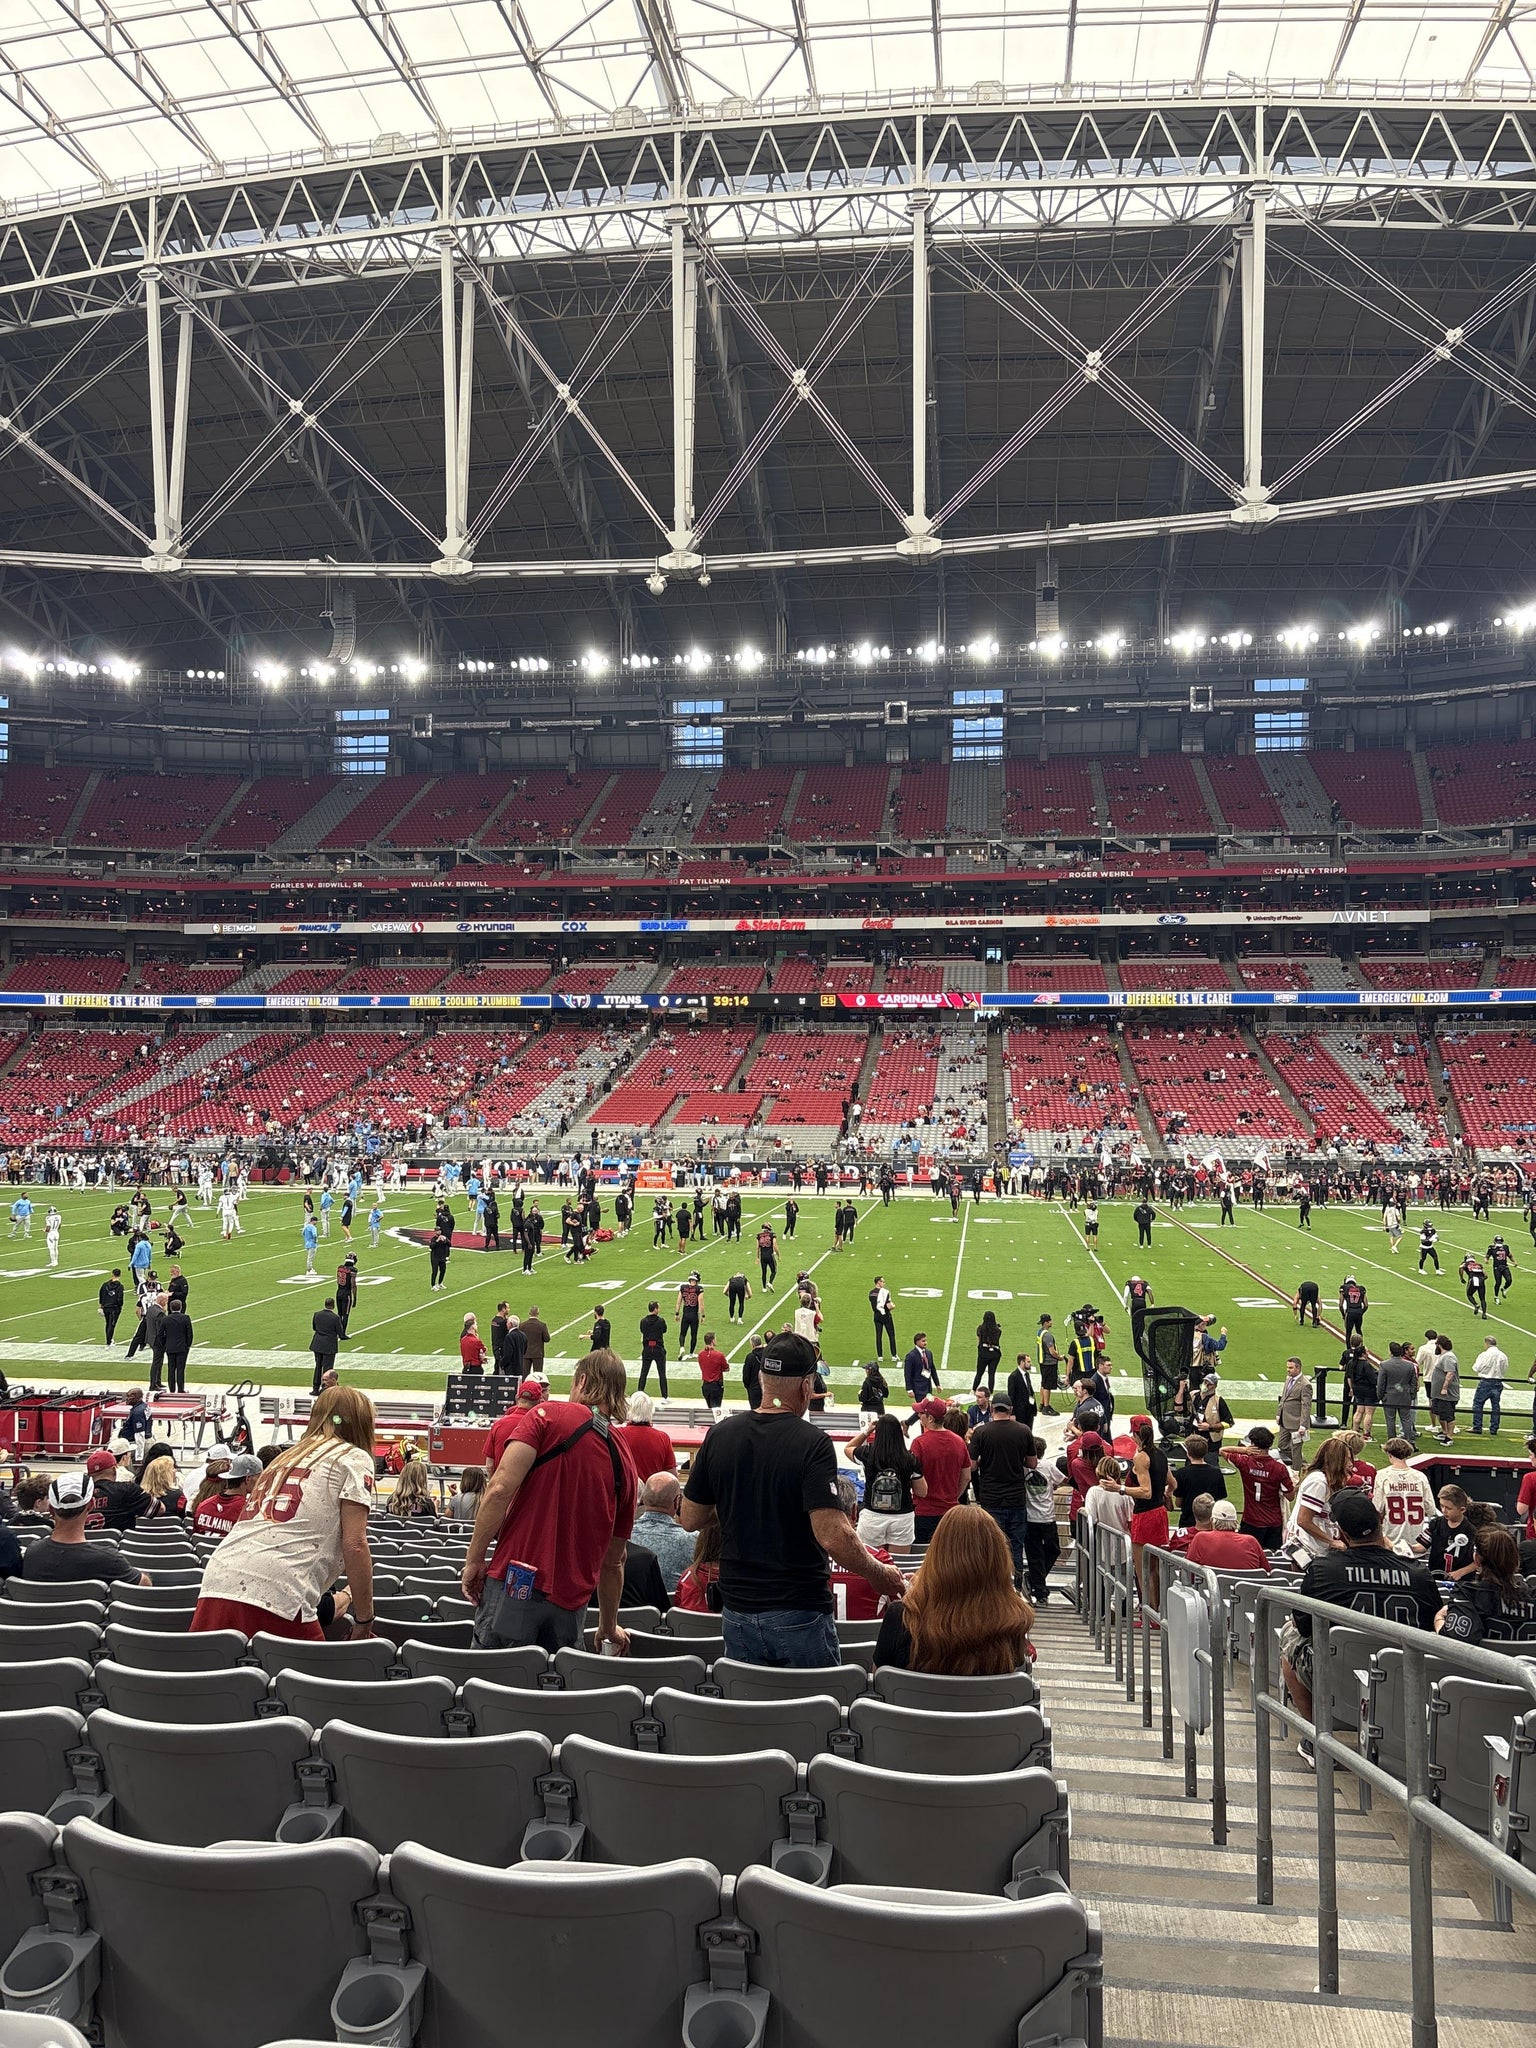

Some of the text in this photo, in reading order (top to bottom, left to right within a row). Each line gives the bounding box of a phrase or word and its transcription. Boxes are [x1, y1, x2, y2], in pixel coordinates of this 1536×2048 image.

[1274, 867, 1316, 875] CHARLEY
[1318, 866, 1348, 874] TRIPPI
[456, 880, 489, 888] BIDWILL
[1162, 915, 1184, 924] Ford
[1331, 911, 1390, 923] AVNET
[222, 924, 257, 932] BETMGM
[298, 924, 329, 932] FINANCIAL
[371, 923, 411, 932] SAFEWAY
[473, 923, 515, 931] HYUNDAI
[561, 922, 588, 932] COX
[641, 922, 688, 930] BUD LIGHT
[44, 994, 162, 1006] THE DIFFERENCE IS WE CARE!
[266, 997, 339, 1006] EMERGENCYAIR.COM
[409, 996, 522, 1006] HEATING COOLING PLUMBING
[603, 995, 669, 1006] TITANS 0
[700, 995, 707, 1006] 1
[713, 995, 749, 1007] 39:14
[822, 996, 834, 1004] 25
[855, 993, 942, 1006] 0 CARDINALS
[1107, 993, 1232, 1004] THE DIFFERENCE IS WE CARE!
[1359, 993, 1449, 1003] EMERGENCYAIR.COM
[1134, 1284, 1143, 1297] 4
[1348, 1290, 1362, 1304] 17
[1248, 1468, 1270, 1479] MURRAY
[1253, 1481, 1262, 1502] 1
[1388, 1482, 1419, 1492] McBRIDE
[1387, 1495, 1424, 1526] 85
[197, 1513, 233, 1531] BEILMANN
[1443, 1552, 1454, 1574] 1
[1345, 1566, 1412, 1587] TILLMAN
[1350, 1591, 1420, 1629] 40
[1500, 1597, 1536, 1619] WATT
[1445, 1612, 1473, 1638] 99
